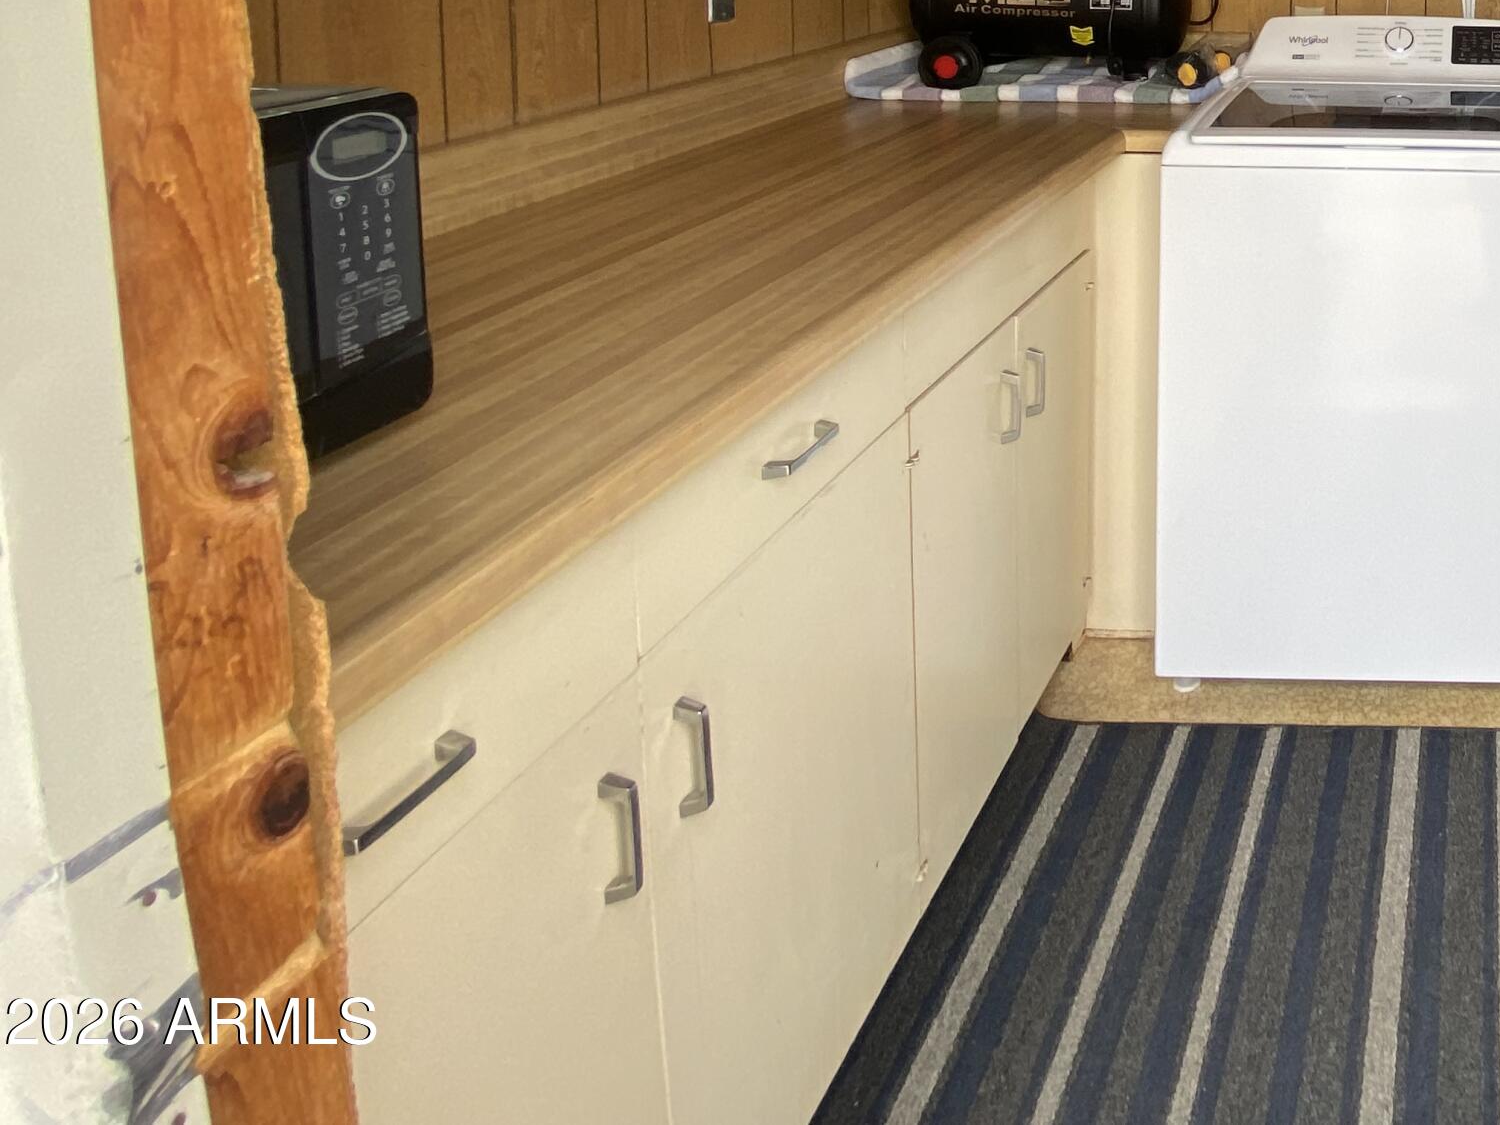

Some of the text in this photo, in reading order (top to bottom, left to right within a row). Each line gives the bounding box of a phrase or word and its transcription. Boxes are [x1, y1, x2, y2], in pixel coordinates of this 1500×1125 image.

[954, 3, 1076, 18] Air Compressor
[1289, 34, 1329, 47] Whirlpool
